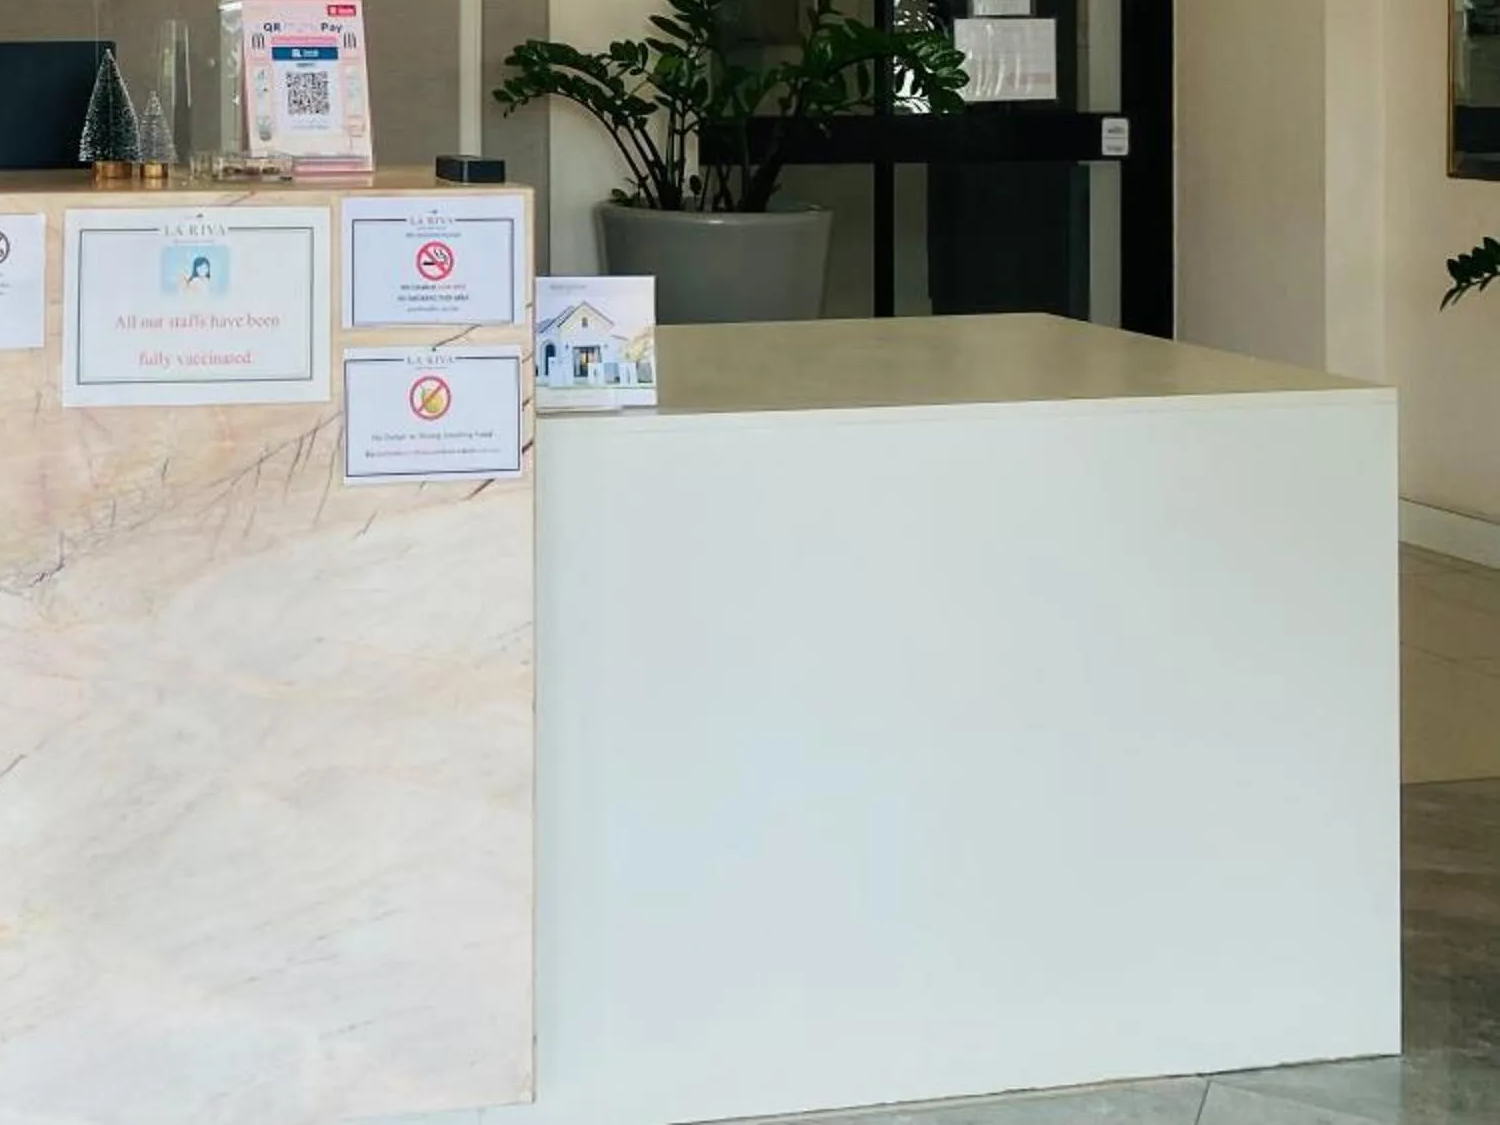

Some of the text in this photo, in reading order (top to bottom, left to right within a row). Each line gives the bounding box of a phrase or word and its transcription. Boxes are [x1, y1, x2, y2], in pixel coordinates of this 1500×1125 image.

[263, 22, 342, 34] QR Pay
[116, 314, 137, 329] All
[210, 312, 244, 329] have
[245, 312, 281, 329] been
[137, 349, 171, 369] fully
